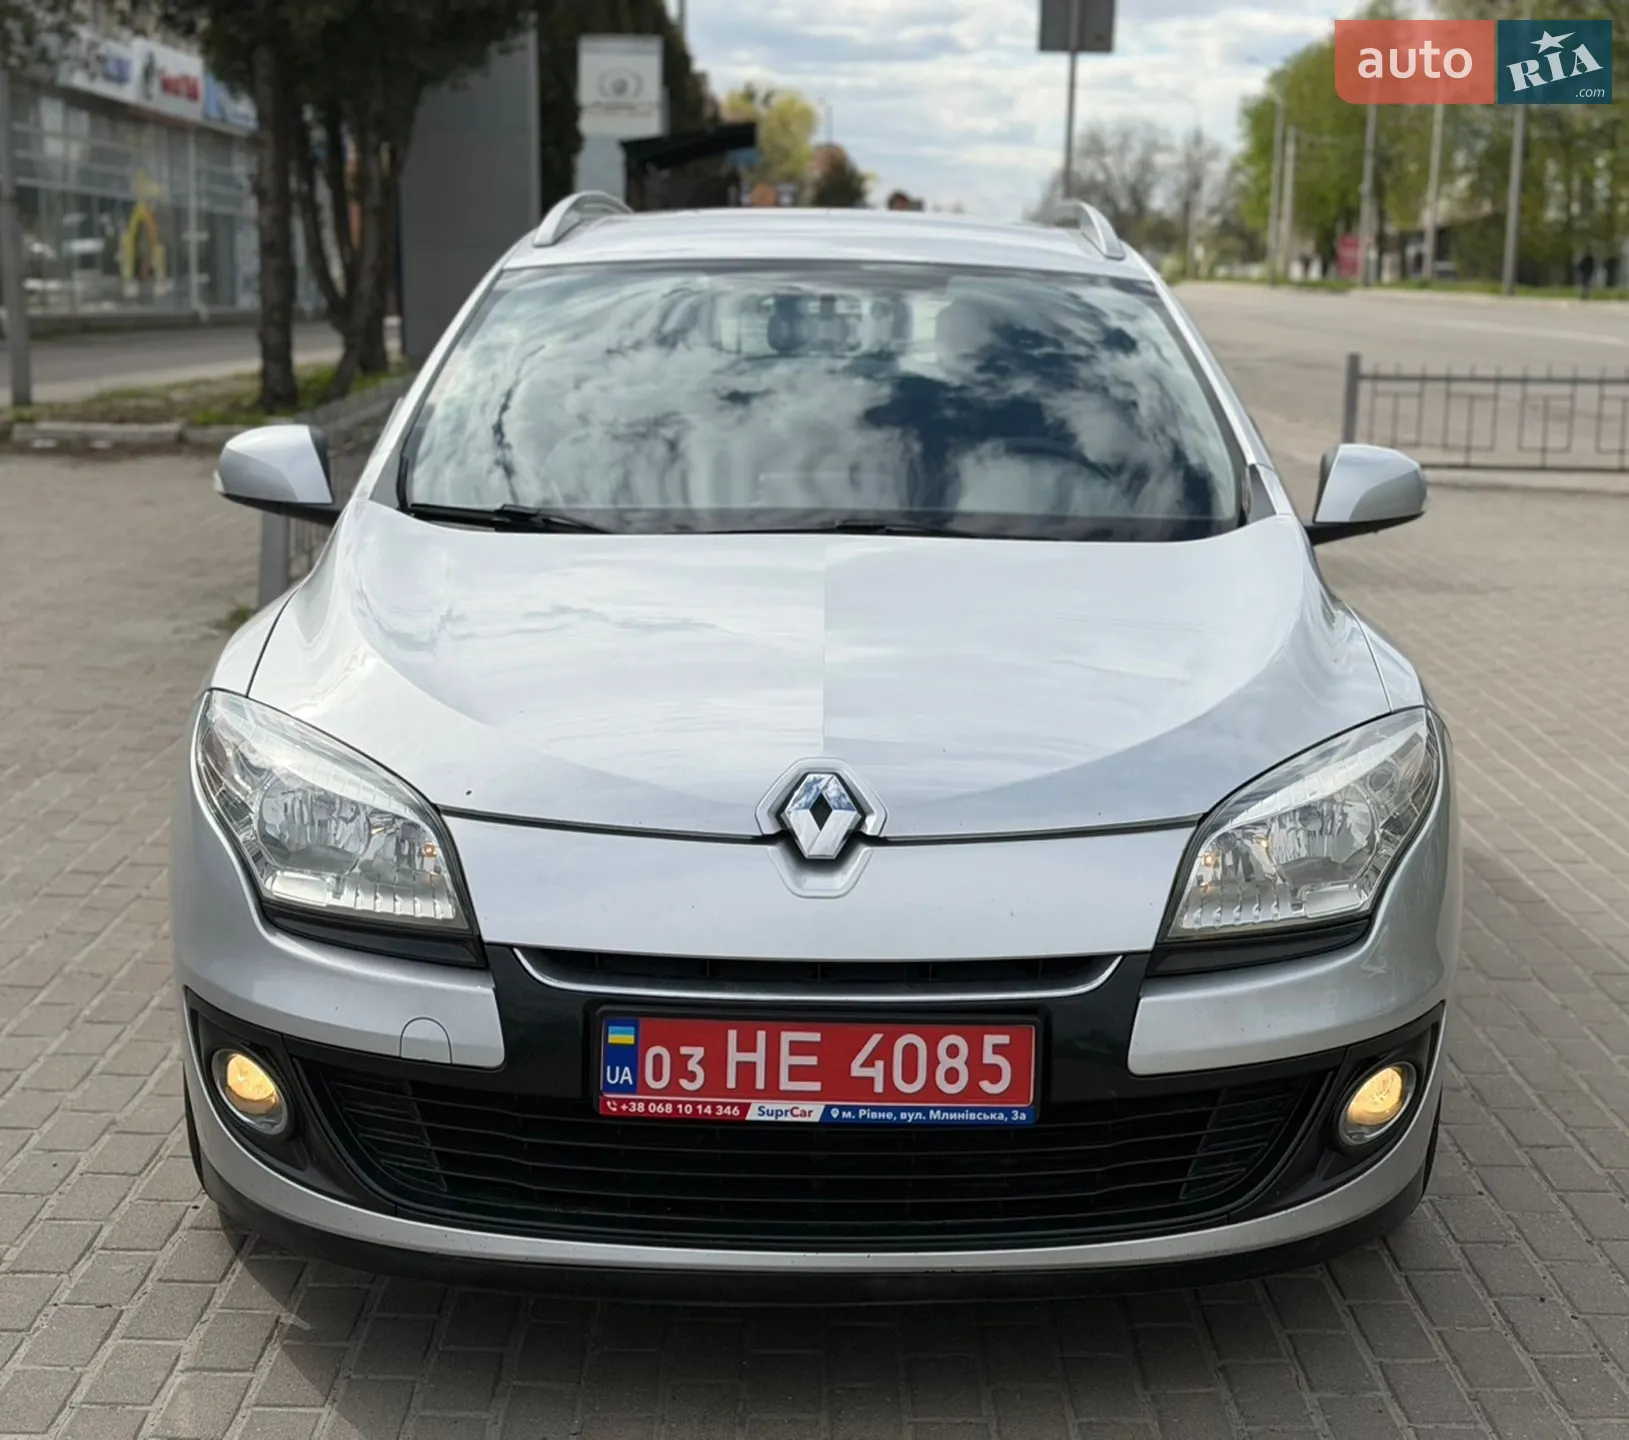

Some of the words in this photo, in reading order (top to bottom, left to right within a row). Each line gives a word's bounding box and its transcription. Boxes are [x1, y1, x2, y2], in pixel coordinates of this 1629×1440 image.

[644, 1045, 705, 1092] 03
[726, 1029, 822, 1091] HE
[850, 1033, 1012, 1094] 4085
[606, 1065, 634, 1085] UA
[620, 1102, 645, 1113] +38
[648, 1102, 673, 1114] 068
[676, 1103, 693, 1115] 10
[696, 1104, 713, 1115] 14
[715, 1105, 740, 1117] 346
[757, 1105, 814, 1119] SuprCar
[842, 1111, 856, 1119] м.
[859, 1109, 897, 1121] Рівне,
[900, 1111, 926, 1122] вул.
[929, 1109, 1008, 1121] Млинівська,
